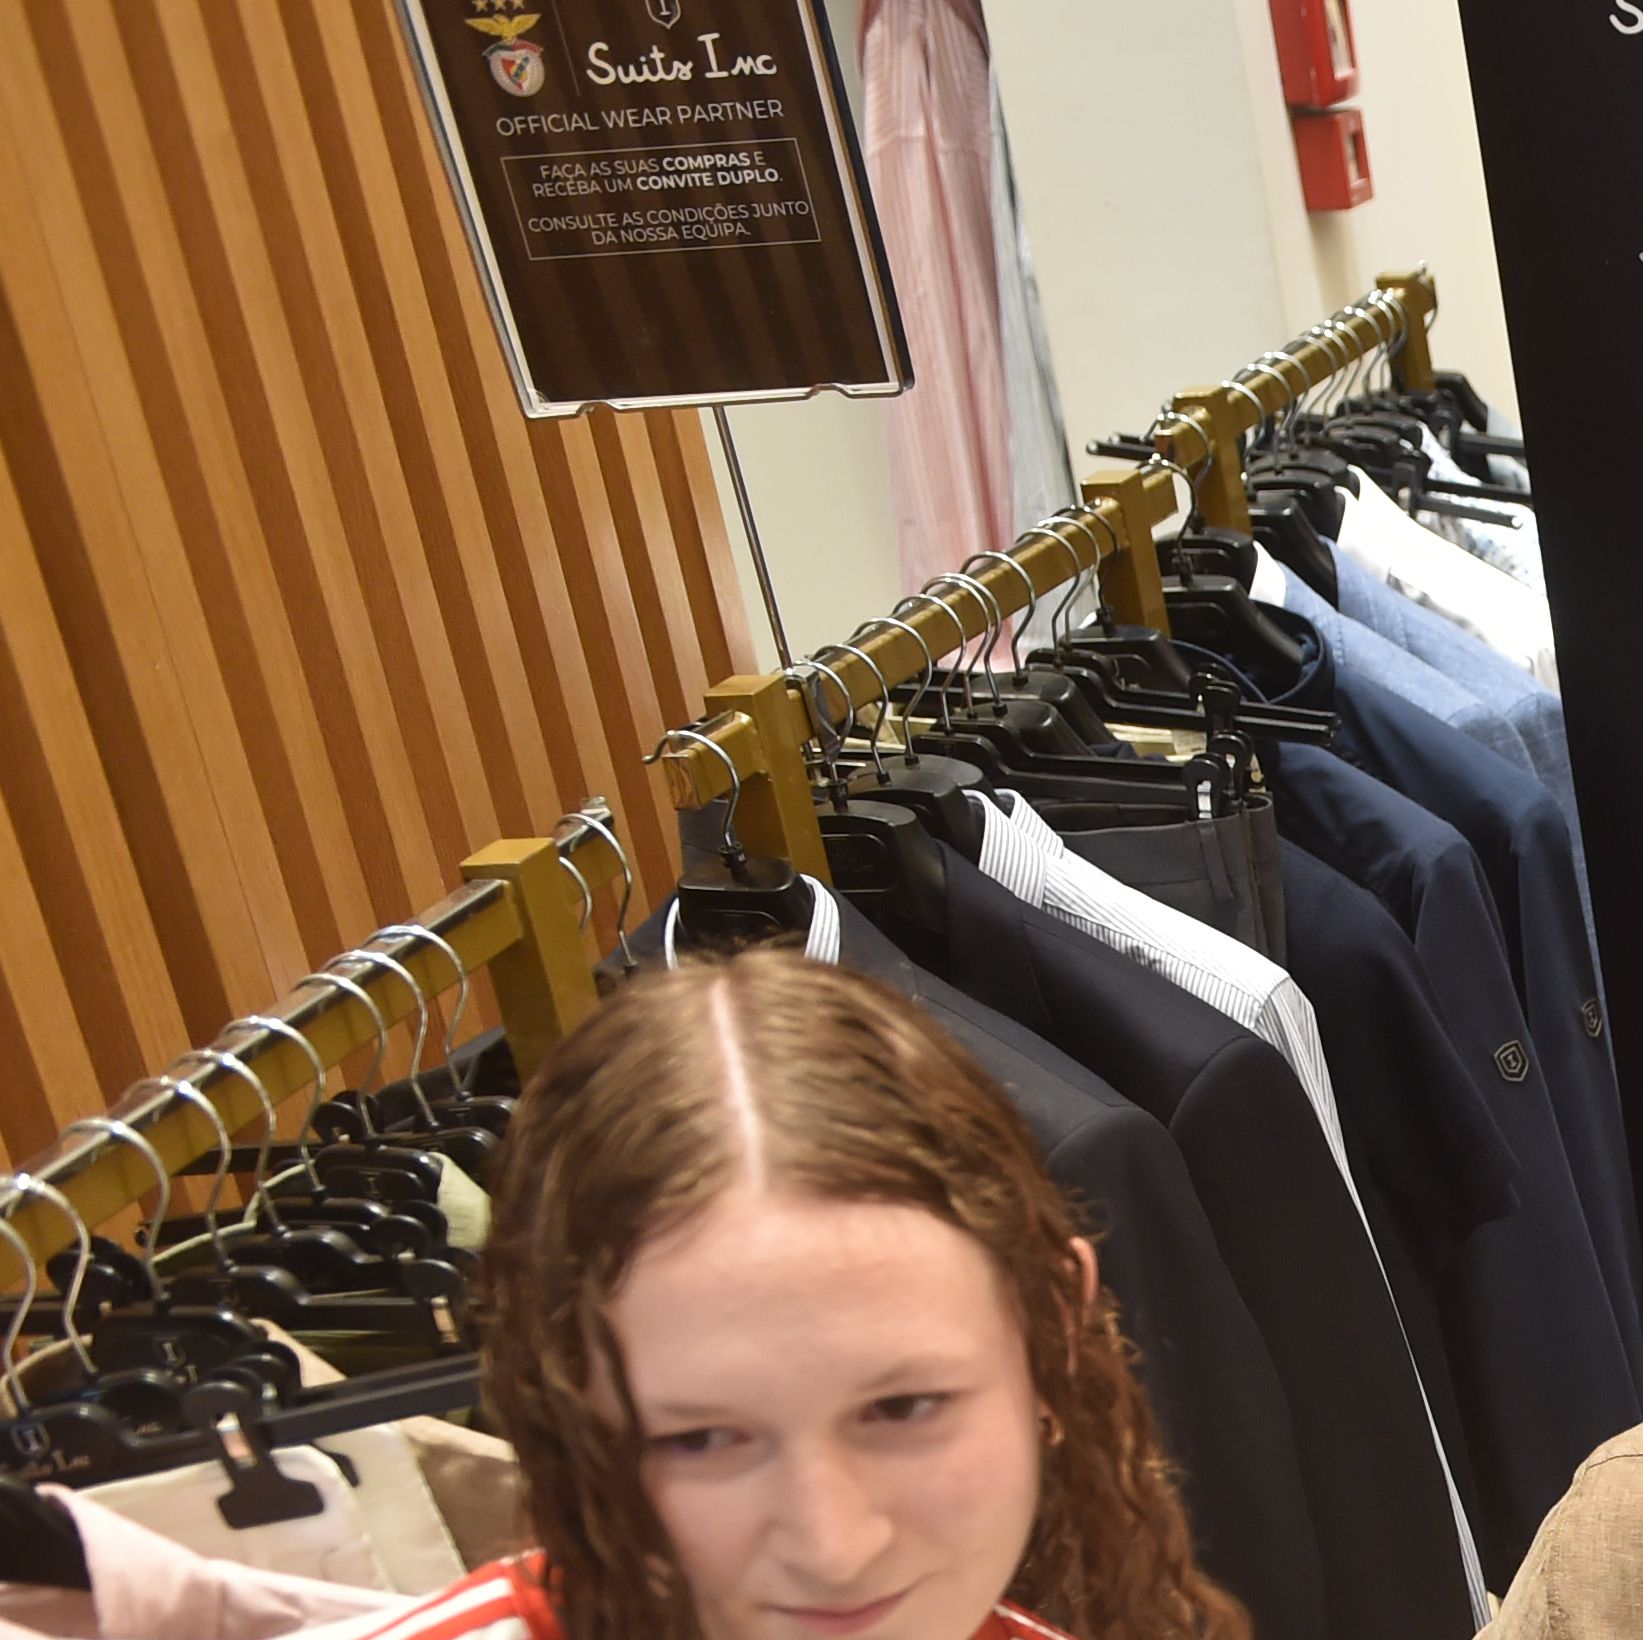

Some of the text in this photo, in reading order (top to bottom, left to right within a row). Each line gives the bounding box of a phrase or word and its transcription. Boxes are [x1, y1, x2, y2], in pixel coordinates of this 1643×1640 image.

[587, 33, 776, 84] Suits Inc
[496, 99, 785, 136] OFFICIAL WEAR PARTNER
[532, 168, 784, 198] RECEBA UM CONVITE DUPLO.
[539, 151, 767, 184] FAÇA AS SUAS COMPRAS E
[528, 200, 809, 233] CONSULTE AS CONDIÇÕES JUNTO
[592, 231, 618, 246] DA
[620, 226, 680, 244] NOSSA
